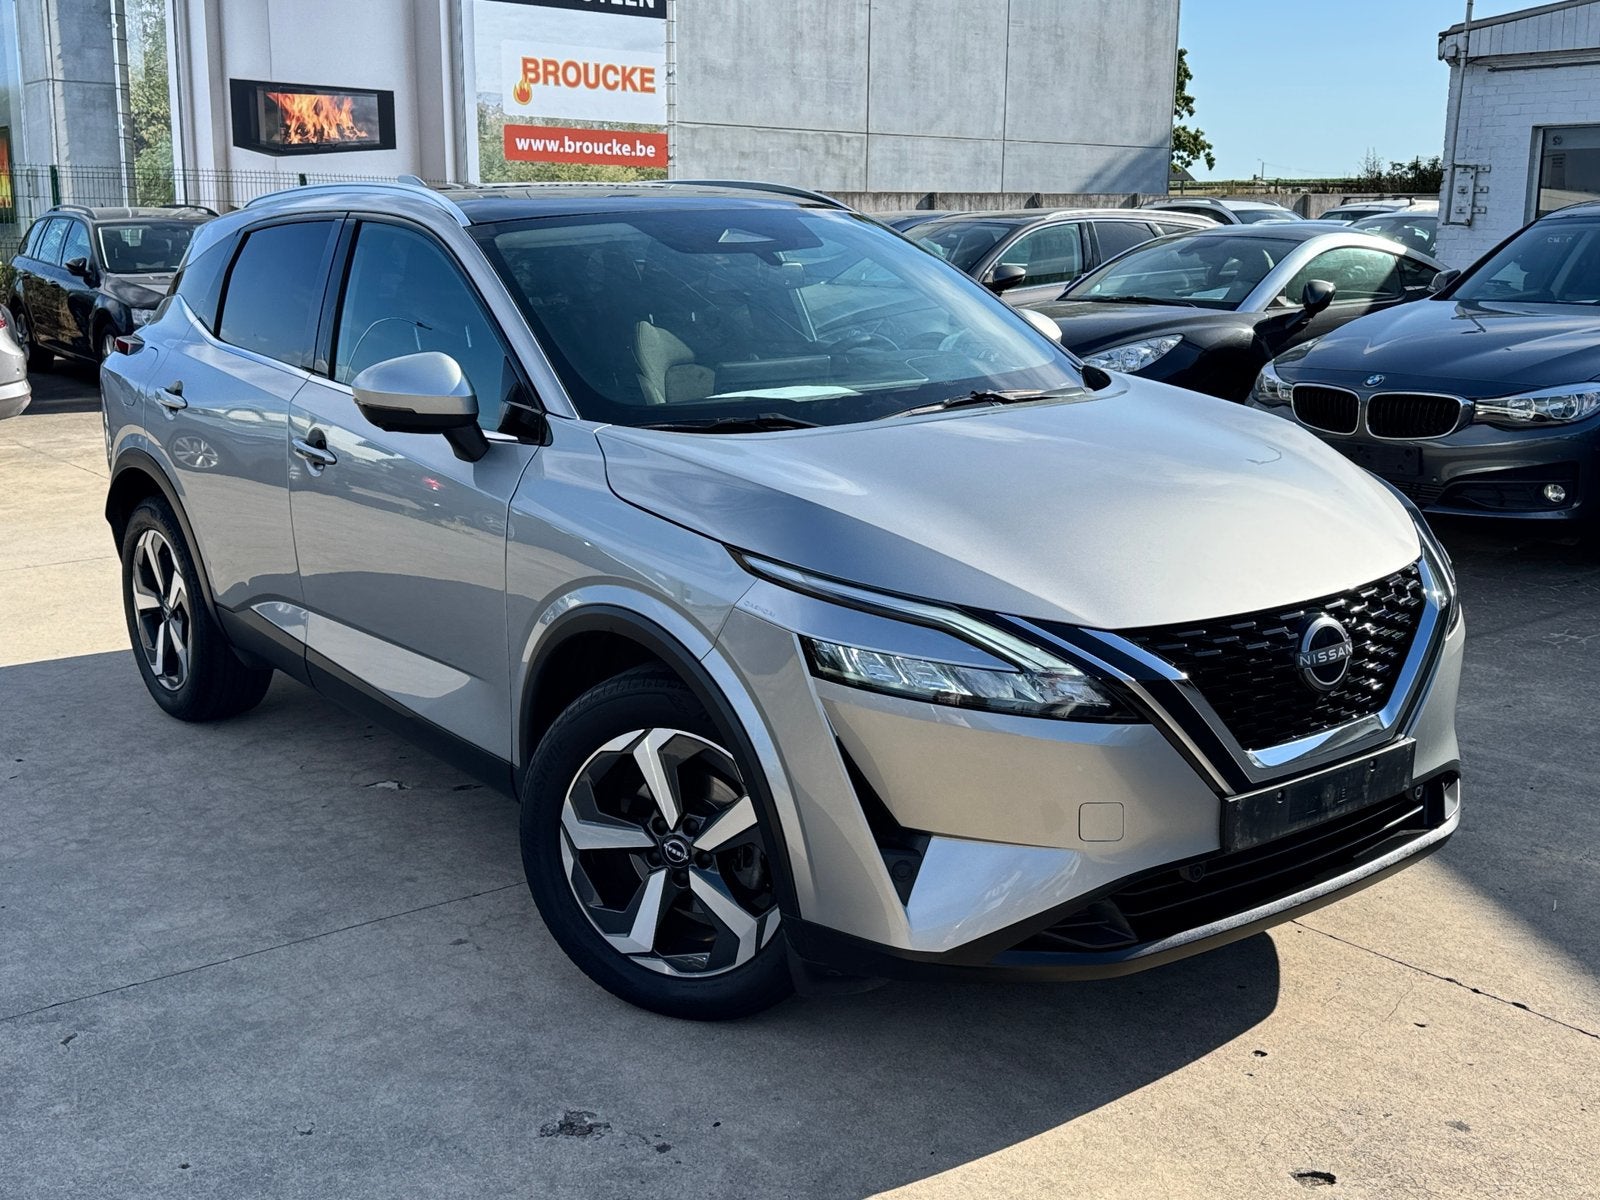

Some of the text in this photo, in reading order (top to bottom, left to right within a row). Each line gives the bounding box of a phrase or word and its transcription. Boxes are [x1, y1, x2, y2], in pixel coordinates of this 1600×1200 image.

[521, 56, 656, 94] BROUCKE
[515, 136, 656, 157] www.broucke.be
[1299, 640, 1353, 667] NISSAN
